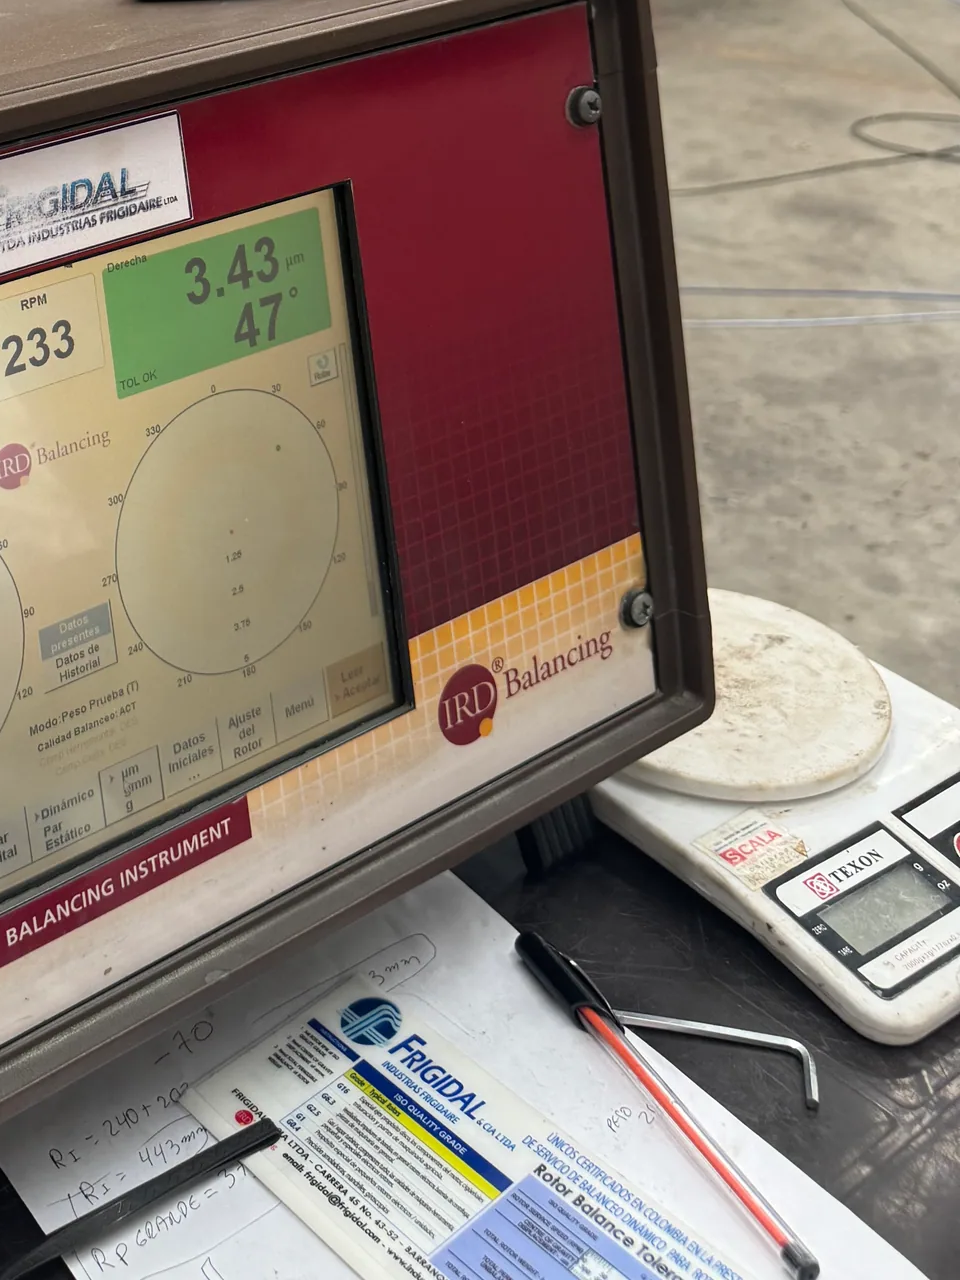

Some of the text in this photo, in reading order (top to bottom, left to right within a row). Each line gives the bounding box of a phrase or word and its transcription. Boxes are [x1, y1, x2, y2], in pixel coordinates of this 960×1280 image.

[28, 218, 98, 245] INDUSTRIAS
[99, 197, 162, 227] FRIGIDAIRE
[106, 252, 148, 274] Derecha
[184, 235, 280, 306] 3.43
[20, 293, 48, 311] RPM
[1, 319, 75, 378] 233
[119, 369, 159, 391] TOL OK
[271, 383, 282, 394] 30
[145, 423, 161, 438] 330
[36, 428, 112, 466] Balancing
[107, 493, 124, 507] 300
[102, 572, 118, 587] 270
[23, 606, 35, 619] 90
[59, 614, 89, 635] Datos
[50, 624, 100, 655] presentes
[127, 642, 144, 656] 240
[55, 641, 100, 670] Datos de
[58, 655, 102, 682] Historial
[177, 673, 193, 688] 210
[242, 665, 256, 678] 180
[441, 630, 613, 730] IRD Balancing
[17, 686, 34, 700] 120
[89, 687, 125, 710] Prueba
[126, 679, 139, 695] (T)
[227, 704, 262, 730] Ajuste
[284, 696, 315, 719] Menú
[37, 730, 72, 752] Calidad
[173, 730, 206, 756] Datos
[239, 724, 256, 741] del
[168, 745, 215, 774] Iniciales
[233, 736, 263, 760] Rotor
[40, 788, 95, 820] Dinámico
[43, 819, 64, 838] Par
[45, 822, 92, 852] Estático
[828, 848, 885, 883] TEXON
[4, 818, 232, 948] BALANCING INSTRUMENT
[811, 923, 828, 935] ZERO
[335, 1081, 351, 1094] G16
[347, 1071, 367, 1087] Grade
[386, 1033, 486, 1121] FRIGIDAL
[319, 1091, 337, 1106] G6.3
[380, 1059, 460, 1125] INDUSTRIAS FRIGIDAIRE
[102, 1107, 139, 1137] 240
[293, 1111, 306, 1122] G1
[304, 1102, 322, 1117] G2.5
[391, 1092, 468, 1155] ISO QUALITY GRADE
[480, 1121, 518, 1152] CIA LTDA
[279, 1151, 307, 1173] email:
[285, 1139, 376, 1219] LTDA CARRERA 45 No.
[520, 1134, 694, 1271] DE SERVICIO DE BALANCEO DINÁMICO PARA
[531, 1162, 639, 1249] Rotor Balance
[545, 1131, 703, 1256] ÚNICOS CERTIFICADOS EN COLOMBIA EN
[509, 1192, 569, 1241] ROTOR SERVICE SPEED
[555, 1205, 599, 1241] QUALITY GRADE
[481, 1227, 520, 1259] TOTAL ROTOR
